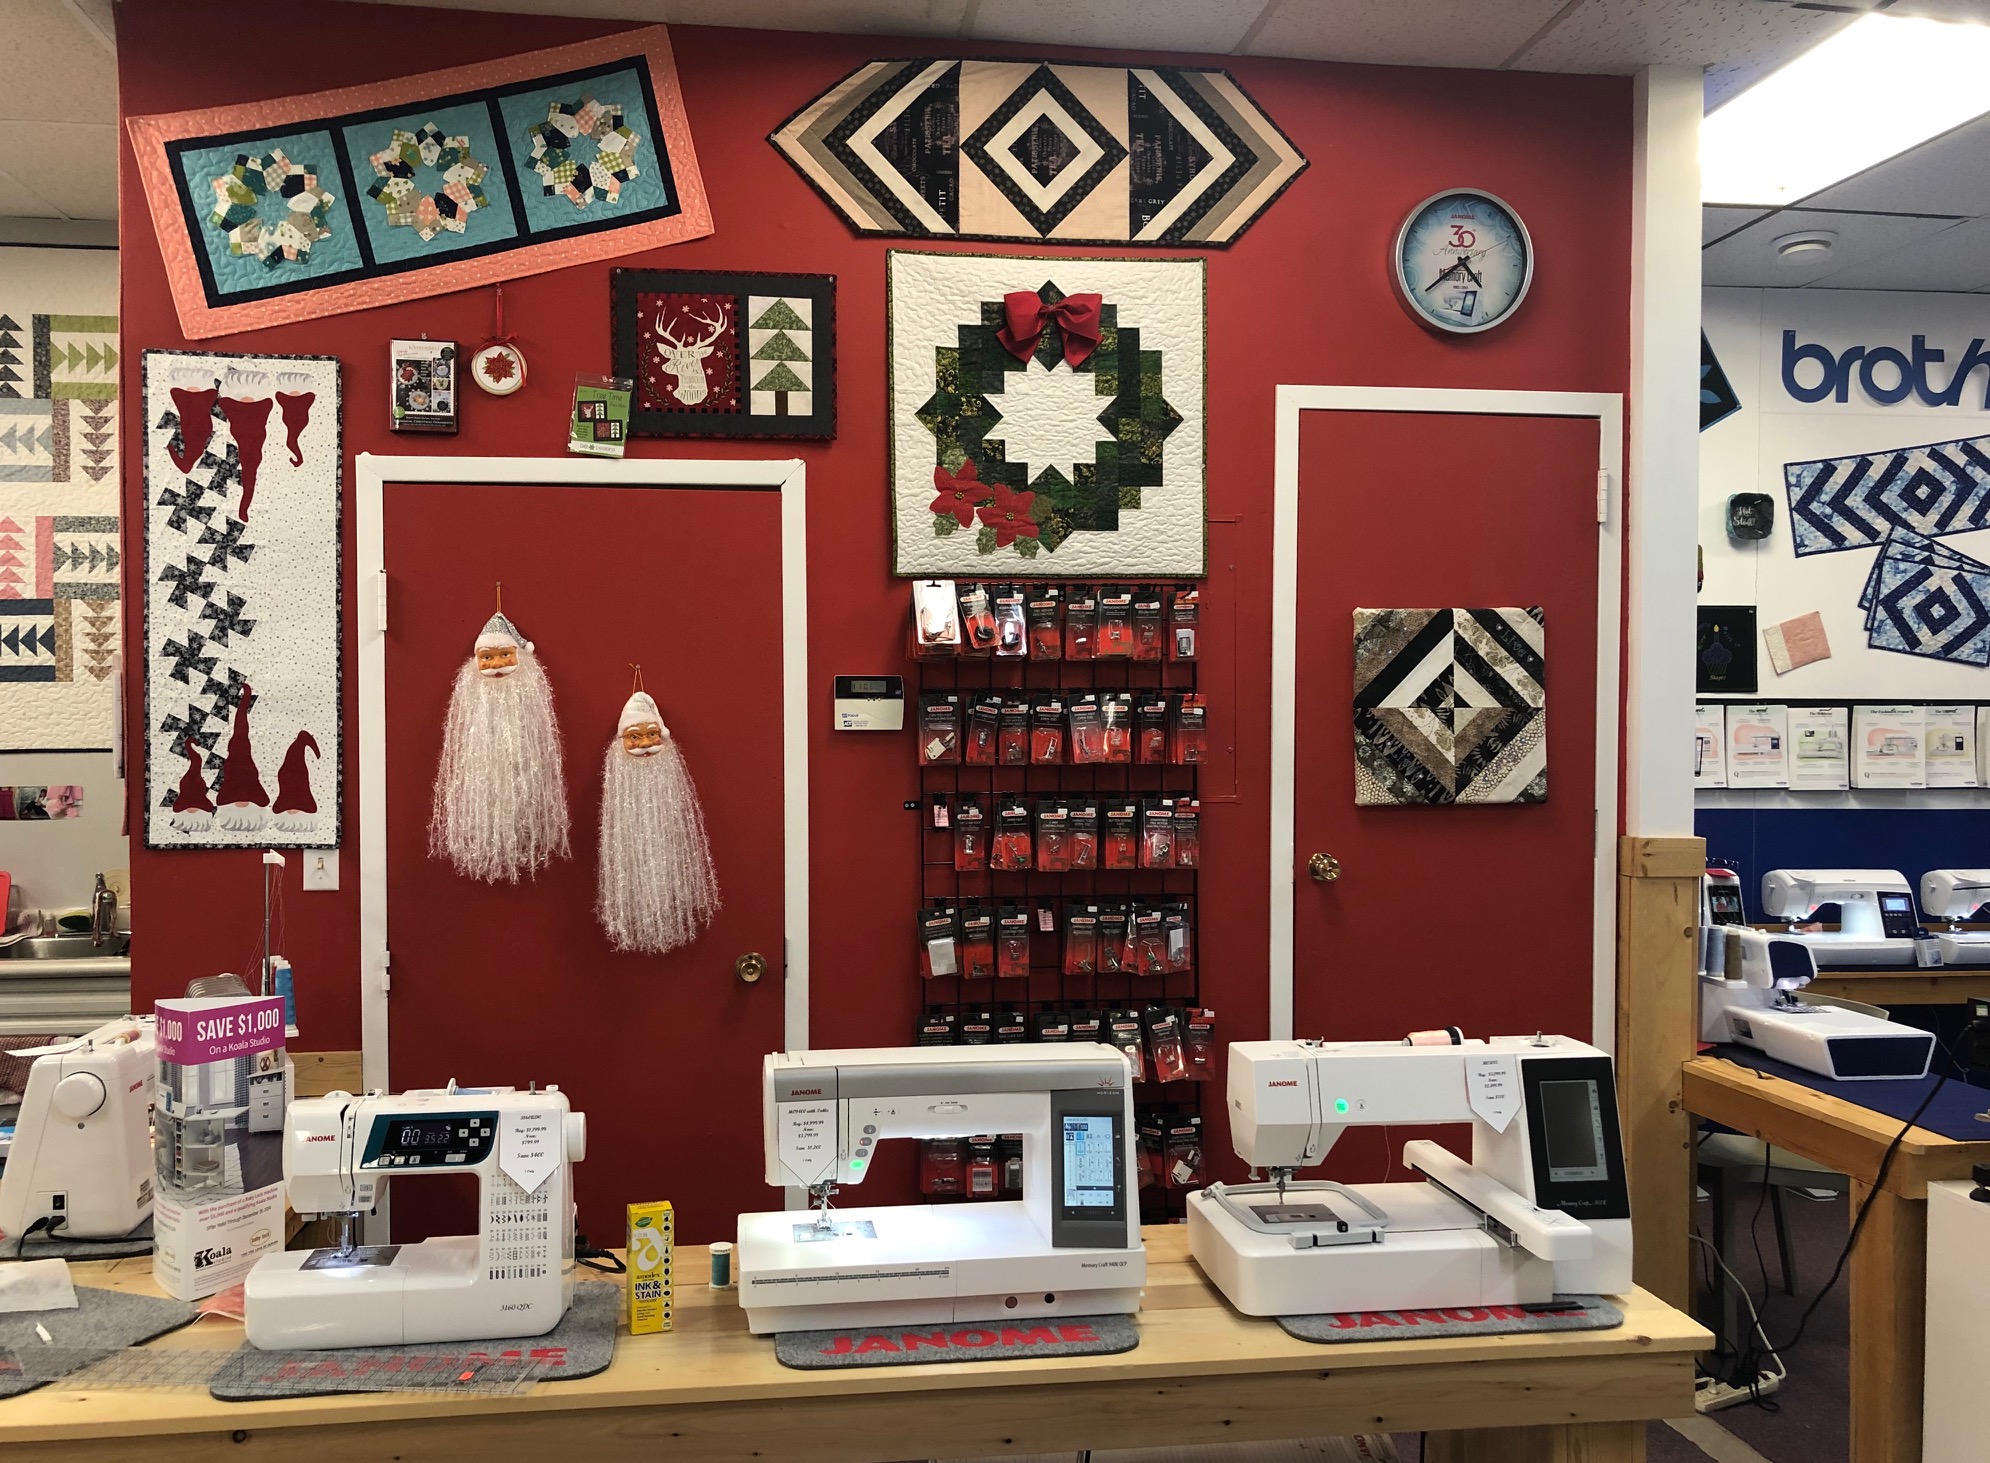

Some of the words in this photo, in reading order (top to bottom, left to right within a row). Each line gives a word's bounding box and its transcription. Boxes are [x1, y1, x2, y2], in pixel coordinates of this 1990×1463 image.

[1448, 224, 1476, 249] 30
[663, 348, 696, 360] OVER
[592, 389, 607, 400] Tree
[196, 1016, 234, 1042] SAVE
[238, 1008, 280, 1036] $1,000
[209, 1045, 221, 1055] On
[222, 1045, 228, 1053] a
[228, 1040, 249, 1052] Koala
[249, 1036, 271, 1048] Studio
[128, 1079, 144, 1094] JANOME
[790, 1088, 823, 1097] JANOME
[251, 1235, 262, 1244] baby
[261, 1231, 270, 1240] lock
[193, 1246, 233, 1270] Koala
[634, 1281, 652, 1291] INK
[652, 1280, 662, 1290] &
[634, 1289, 662, 1300] STAIN
[500, 1303, 517, 1311] 3160
[516, 1302, 534, 1311] QDC
[818, 1323, 1101, 1355] JANOME
